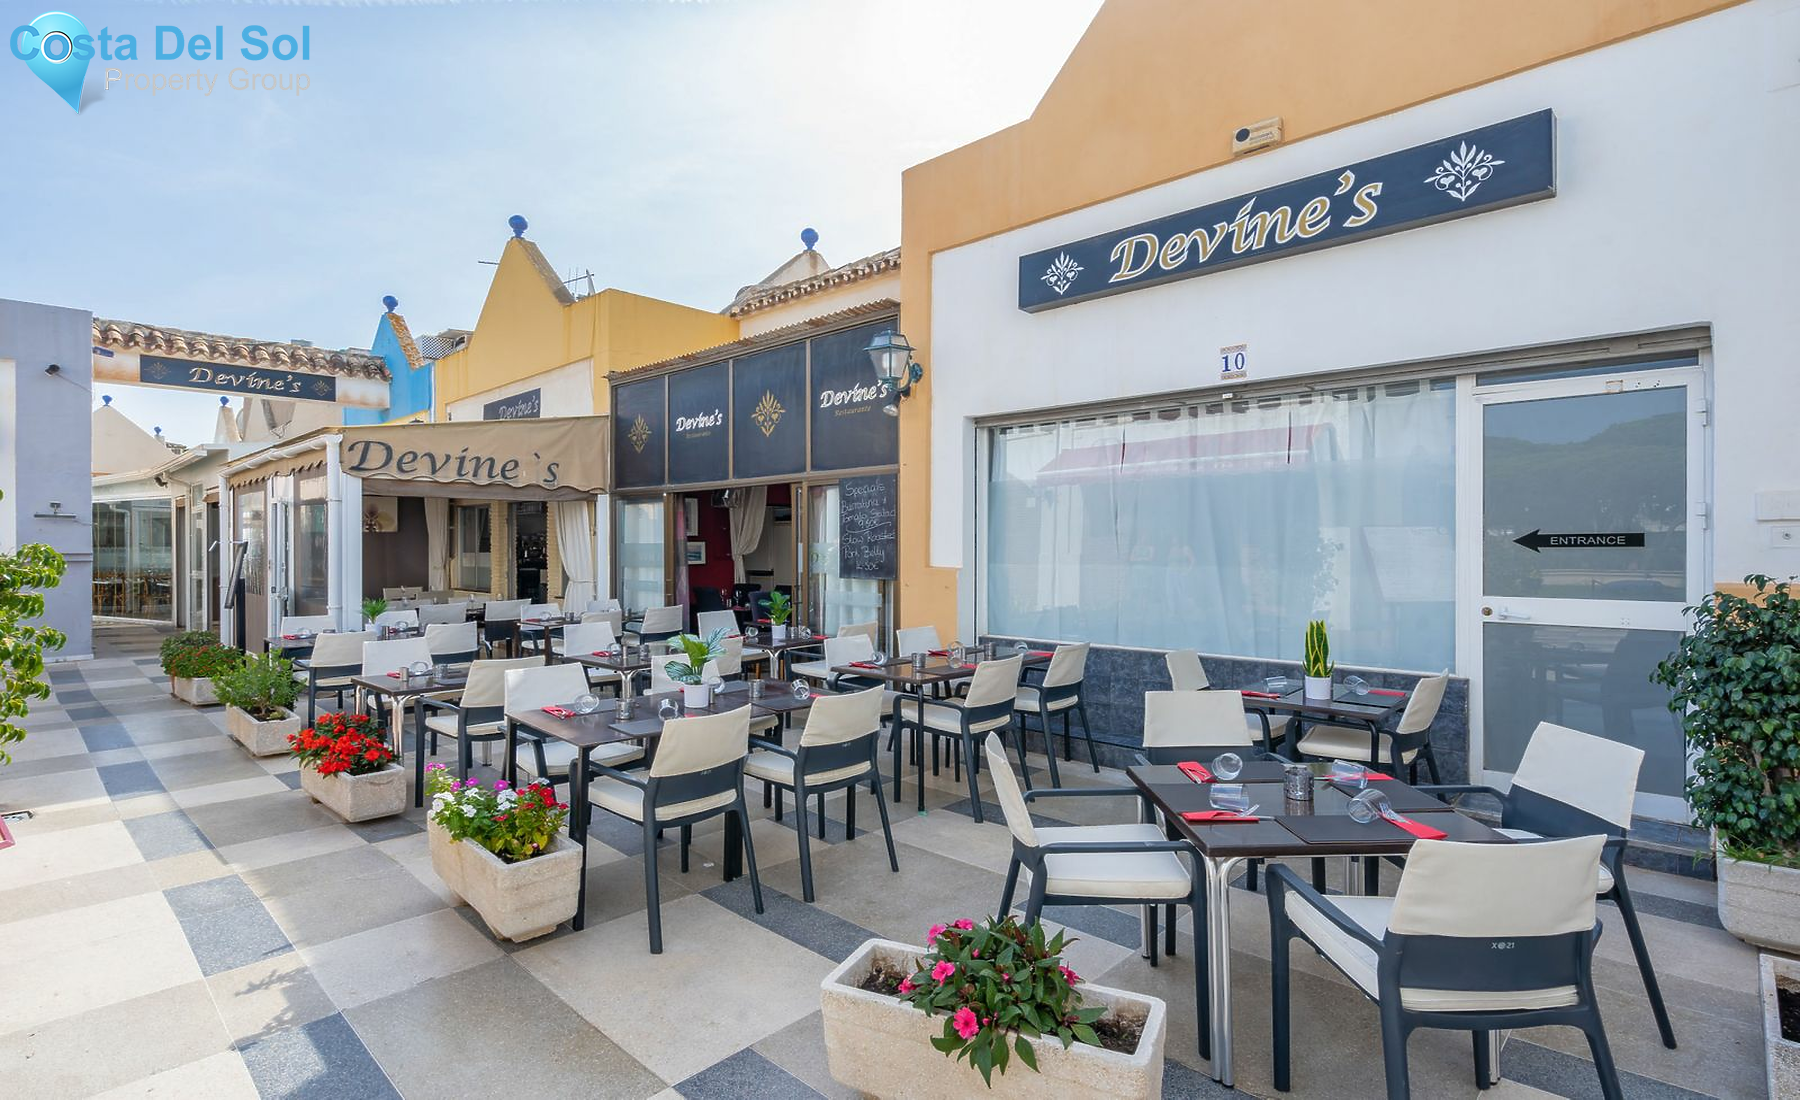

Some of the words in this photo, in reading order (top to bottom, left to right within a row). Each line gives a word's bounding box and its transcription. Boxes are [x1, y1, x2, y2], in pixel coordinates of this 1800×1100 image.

[1108, 170, 1383, 283] Devine's
[1222, 352, 1245, 372] 10
[189, 367, 301, 393] Devine's
[675, 409, 723, 431] Devine's
[1550, 535, 1626, 546] ENTRANCE
